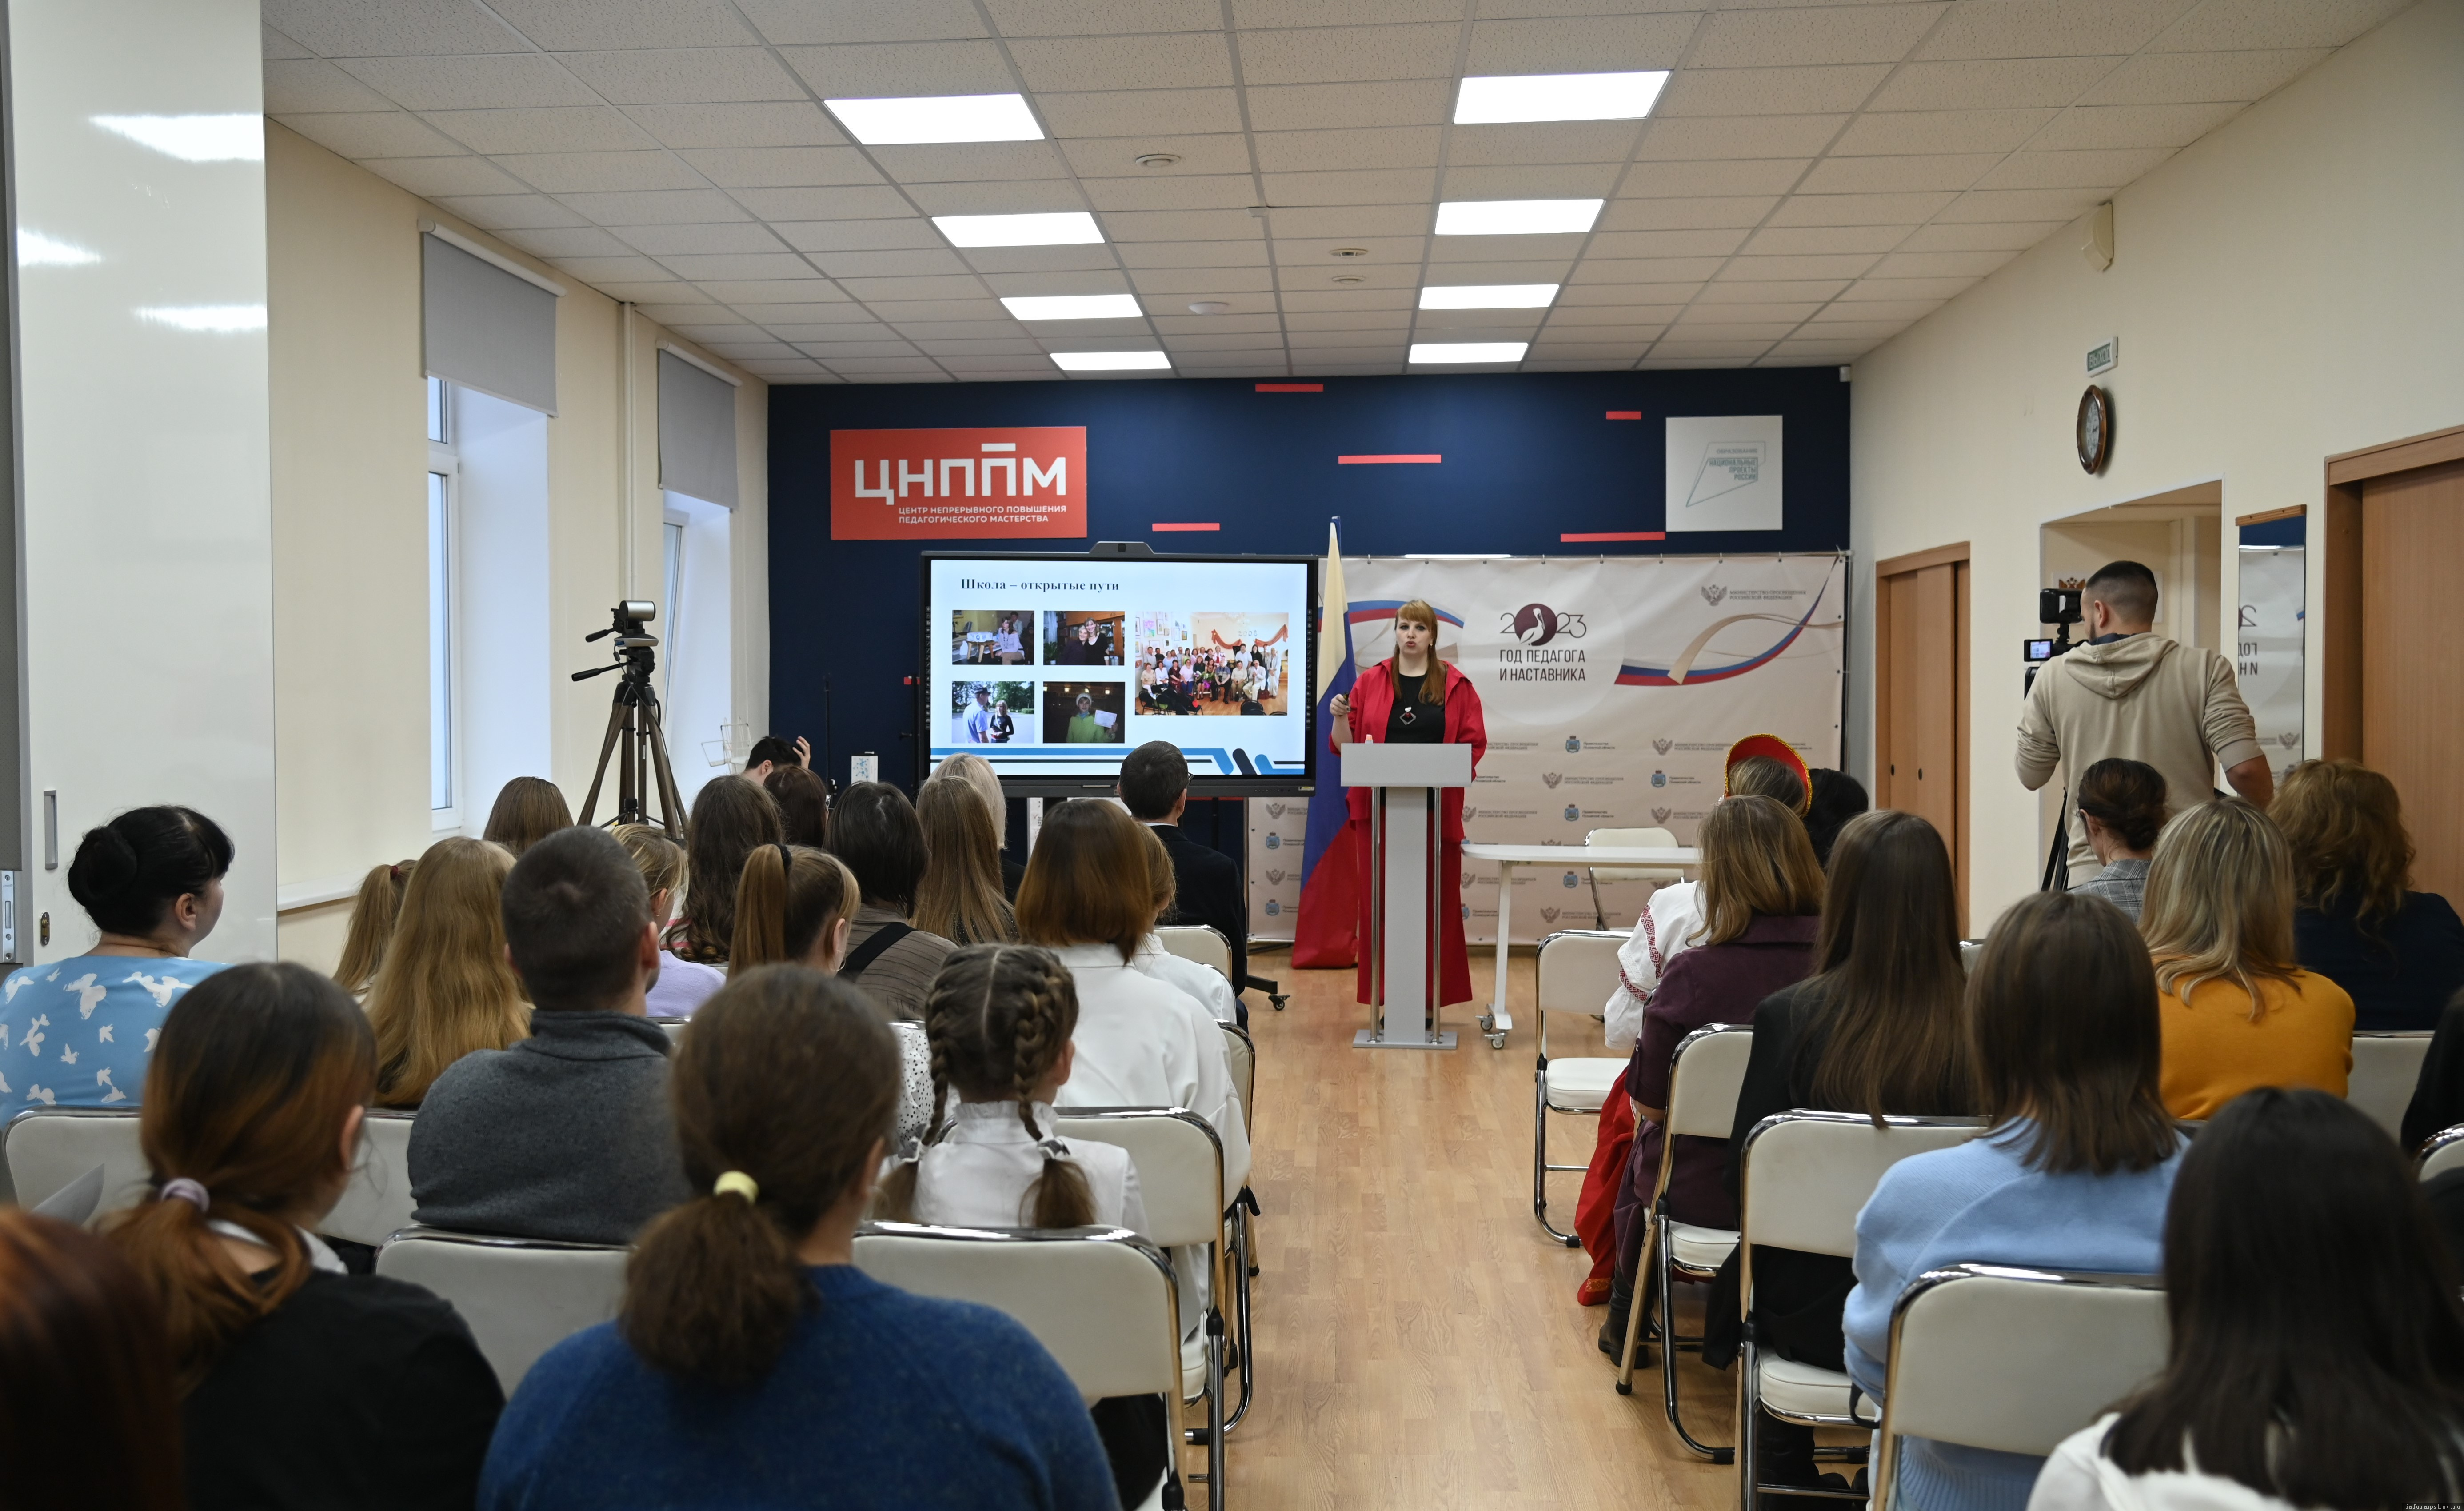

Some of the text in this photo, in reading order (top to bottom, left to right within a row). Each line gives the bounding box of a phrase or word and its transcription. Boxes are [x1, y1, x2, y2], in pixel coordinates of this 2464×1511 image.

[855, 443, 1066, 505] ЦНППМ
[930, 506, 1004, 514] НЕПРЕРЫВНОГО
[899, 516, 987, 524] ПЕДАГОГИЧЕСКОГО
[961, 579, 1006, 589] Школа
[1021, 581, 1086, 592] открытые
[1089, 582, 1119, 593] пути
[1500, 649, 1585, 664] ГОД ПЕДАГОГА
[1500, 668, 1585, 681] И НАСТАВНИКА
